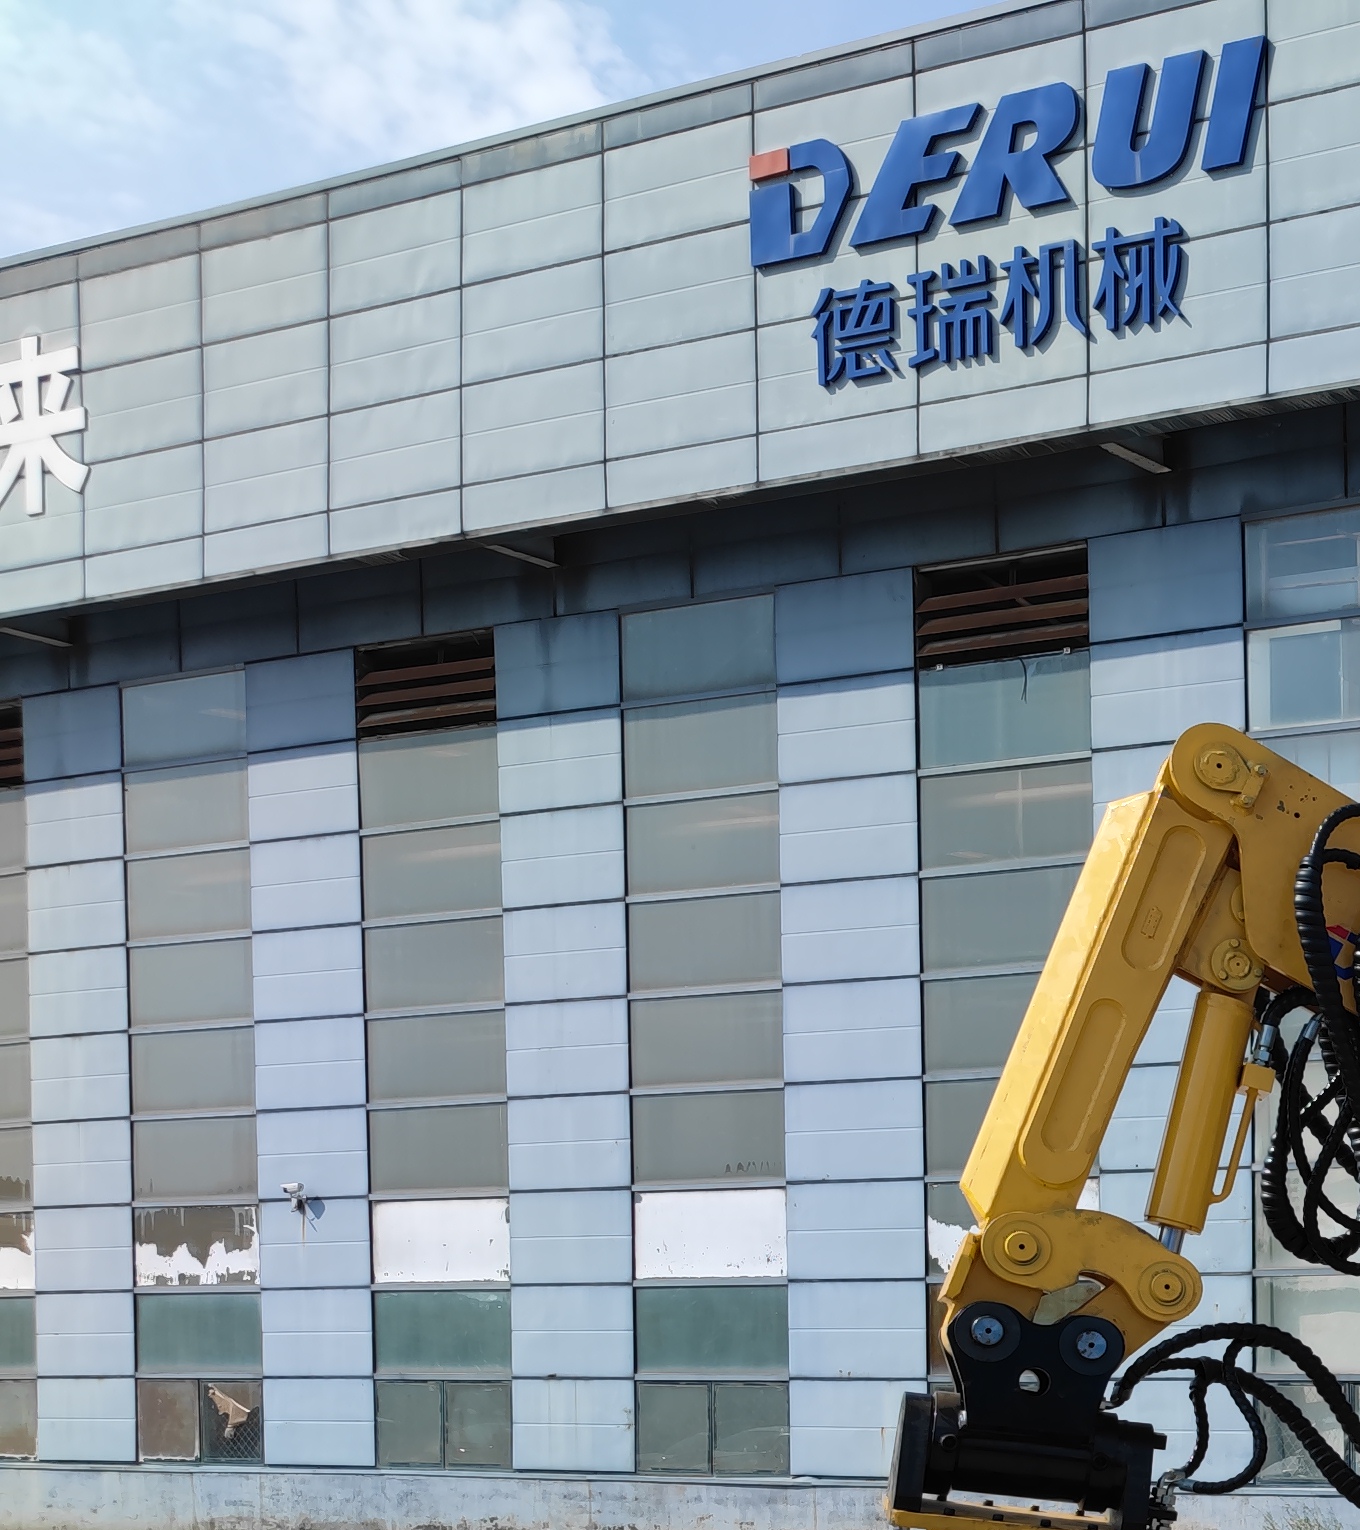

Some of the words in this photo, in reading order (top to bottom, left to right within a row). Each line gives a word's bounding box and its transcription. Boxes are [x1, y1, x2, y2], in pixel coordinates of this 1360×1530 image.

[749, 34, 1269, 269] DERUI
[811, 217, 1189, 387] 德瑞机械
[0, 335, 91, 517] 来
